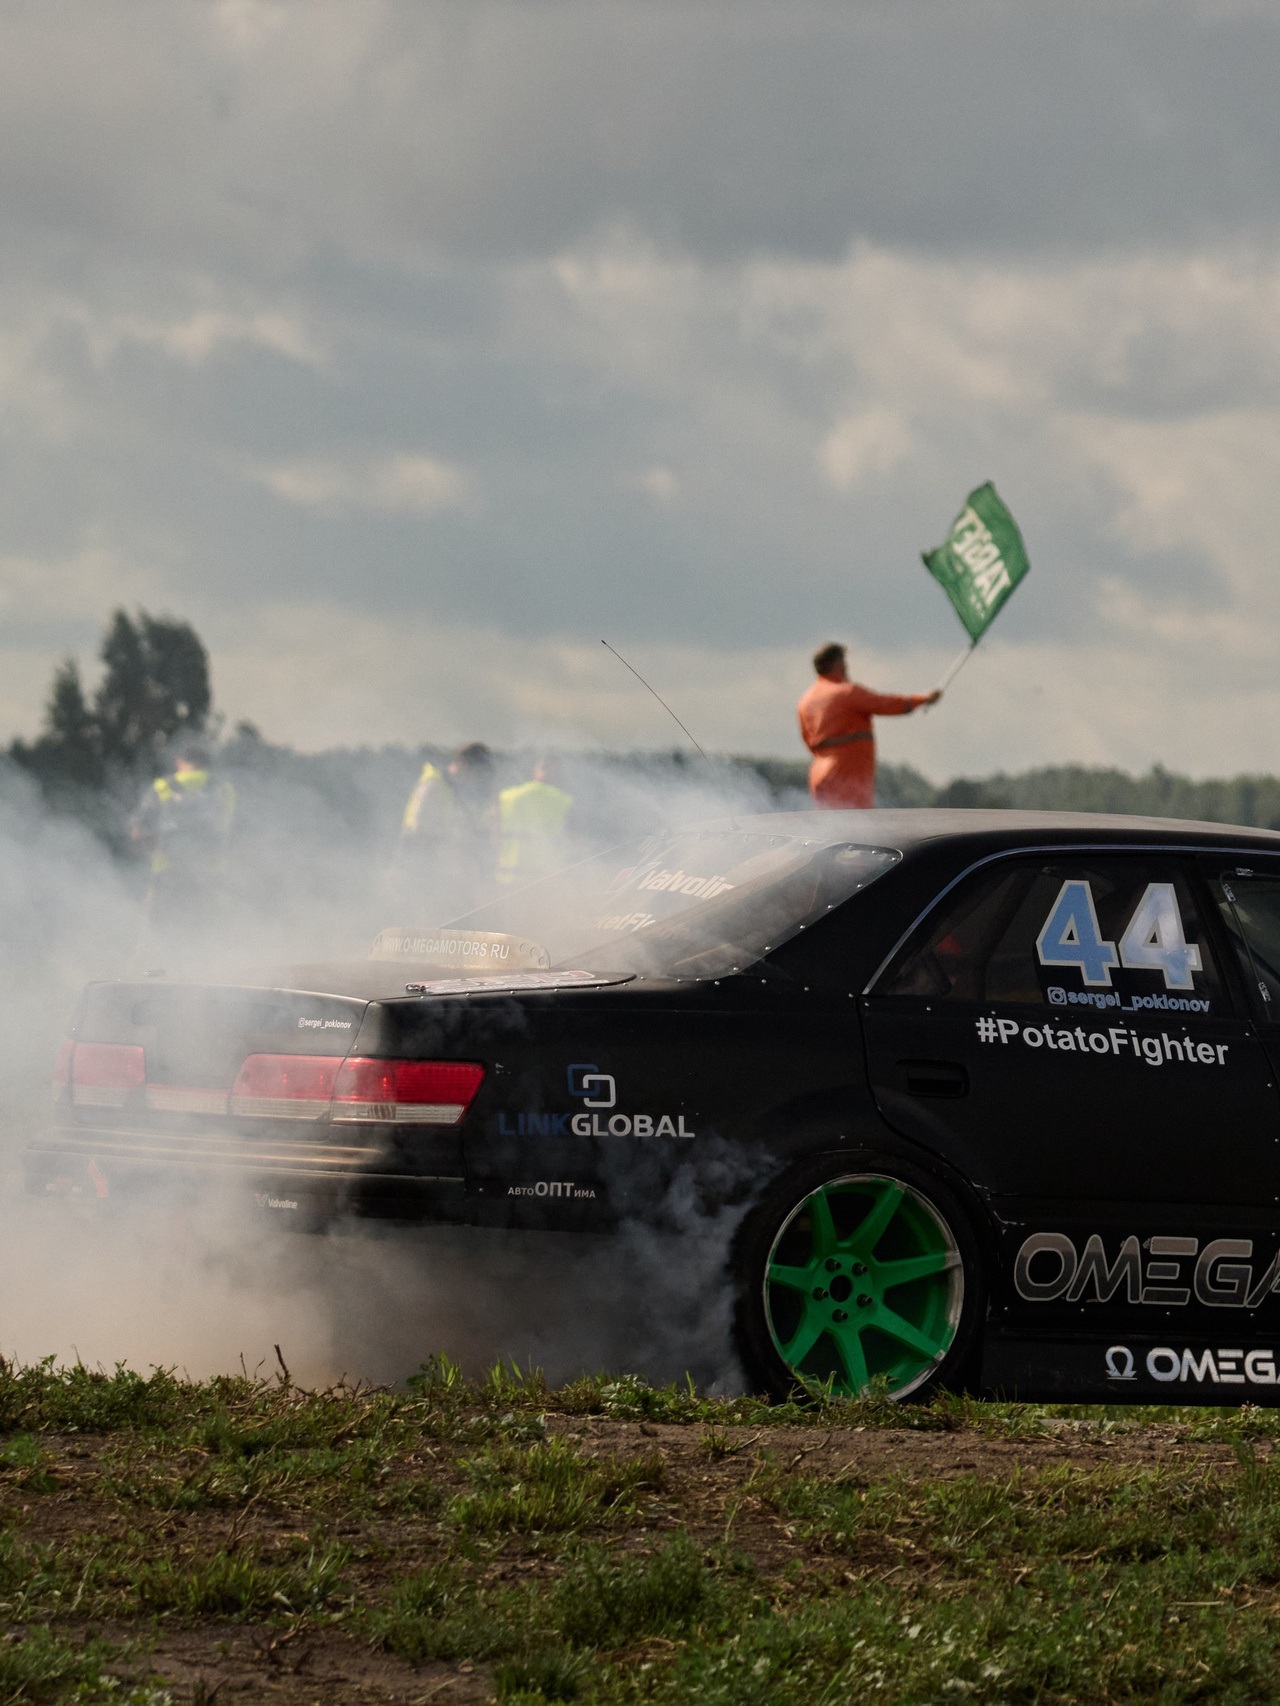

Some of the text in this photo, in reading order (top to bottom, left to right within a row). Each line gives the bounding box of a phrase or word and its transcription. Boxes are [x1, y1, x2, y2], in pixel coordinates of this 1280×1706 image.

[1035, 879, 1203, 990] 44
[975, 1016, 1229, 1066] #PotatoFighter
[498, 1112, 695, 1138] LINKGLOBAL
